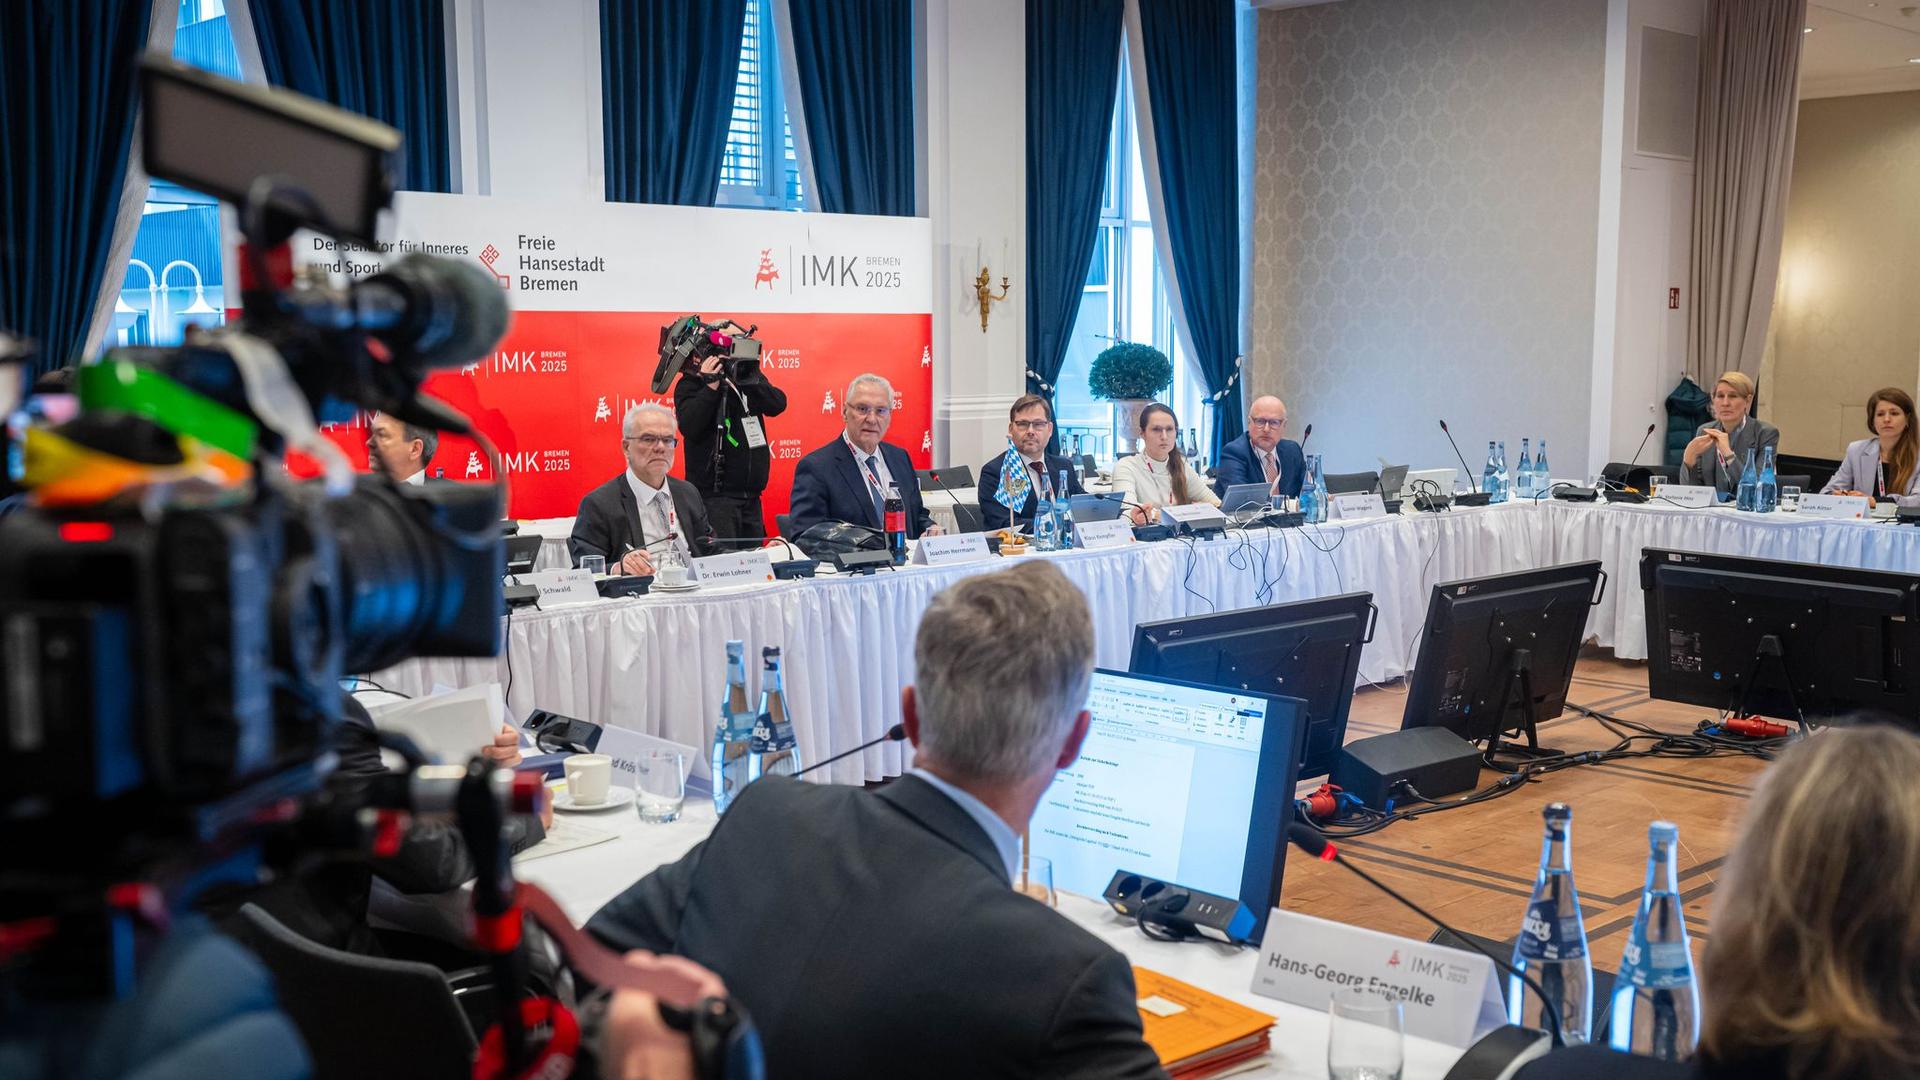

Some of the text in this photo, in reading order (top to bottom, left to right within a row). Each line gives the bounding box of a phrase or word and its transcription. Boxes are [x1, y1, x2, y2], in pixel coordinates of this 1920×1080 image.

[313, 238, 337, 251] Der
[399, 239, 418, 254] für
[422, 241, 469, 255] Inneres
[518, 234, 556, 251] Freie
[346, 261, 382, 277] Sport
[520, 255, 605, 272] Hansestadt
[866, 256, 901, 266] BREMEN
[802, 255, 859, 287] IMK
[520, 275, 578, 291] Bremen
[866, 271, 901, 288] 2025
[494, 351, 537, 373] IMK
[540, 360, 567, 372] 2025
[777, 358, 800, 369] 2025
[543, 449, 570, 457] BREMEN
[779, 447, 802, 459] 2025
[498, 451, 540, 473] IMK
[544, 459, 570, 472] 2025
[713, 570, 731, 578] Erwin
[542, 585, 572, 594] Schwald
[1268, 952, 1363, 993] Hans-Georg
[1411, 956, 1446, 979] IMK
